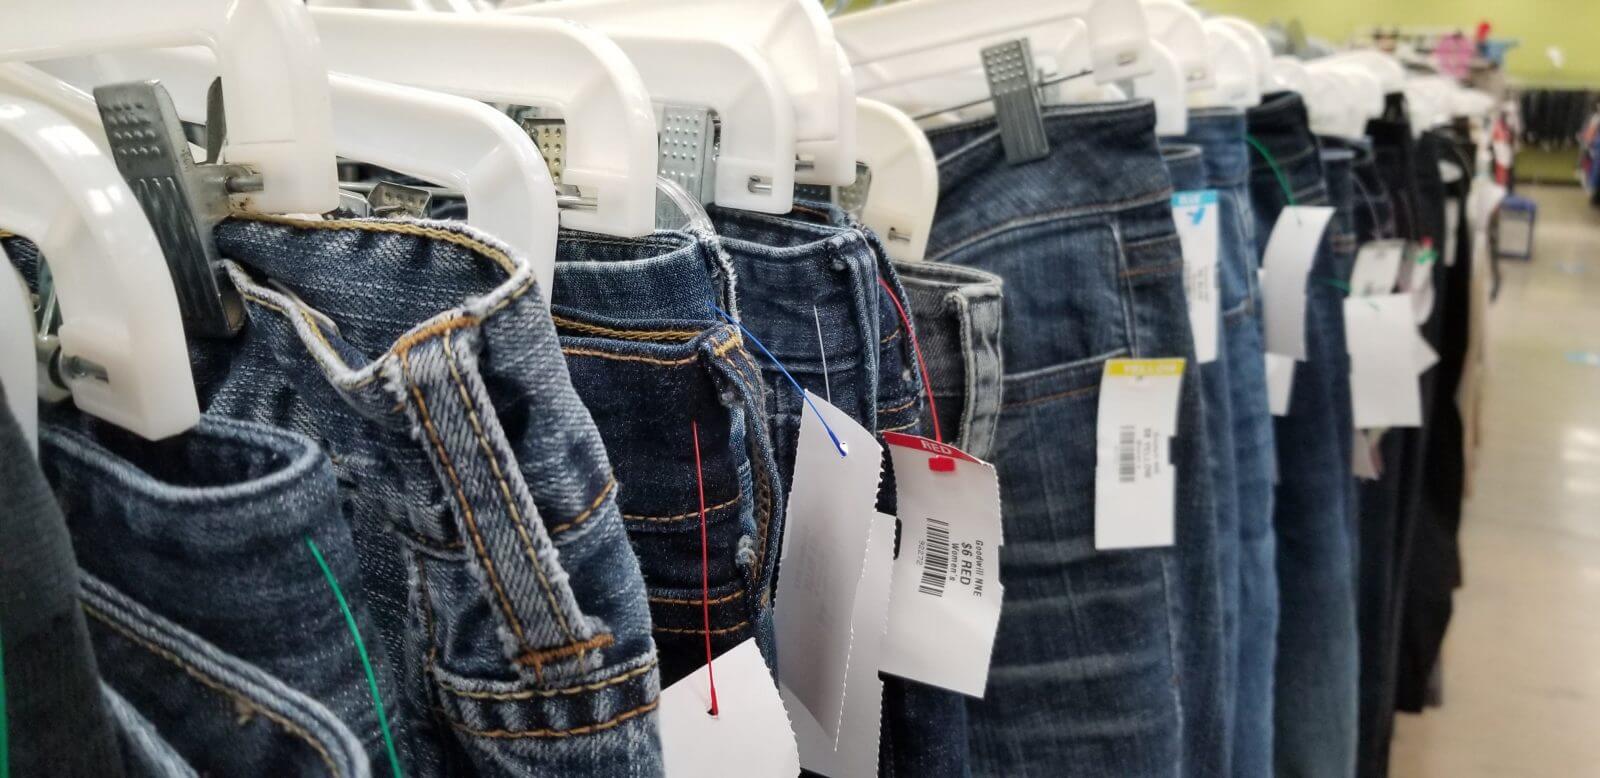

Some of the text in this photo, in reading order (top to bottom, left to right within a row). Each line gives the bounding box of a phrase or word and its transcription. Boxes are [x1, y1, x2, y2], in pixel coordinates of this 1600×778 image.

[1123, 362, 1177, 373] YELLOW
[920, 439, 952, 455] RED
[949, 543, 960, 582] Women's
[960, 542, 973, 585] $6 RED
[973, 539, 984, 598] Goodwill NNE
